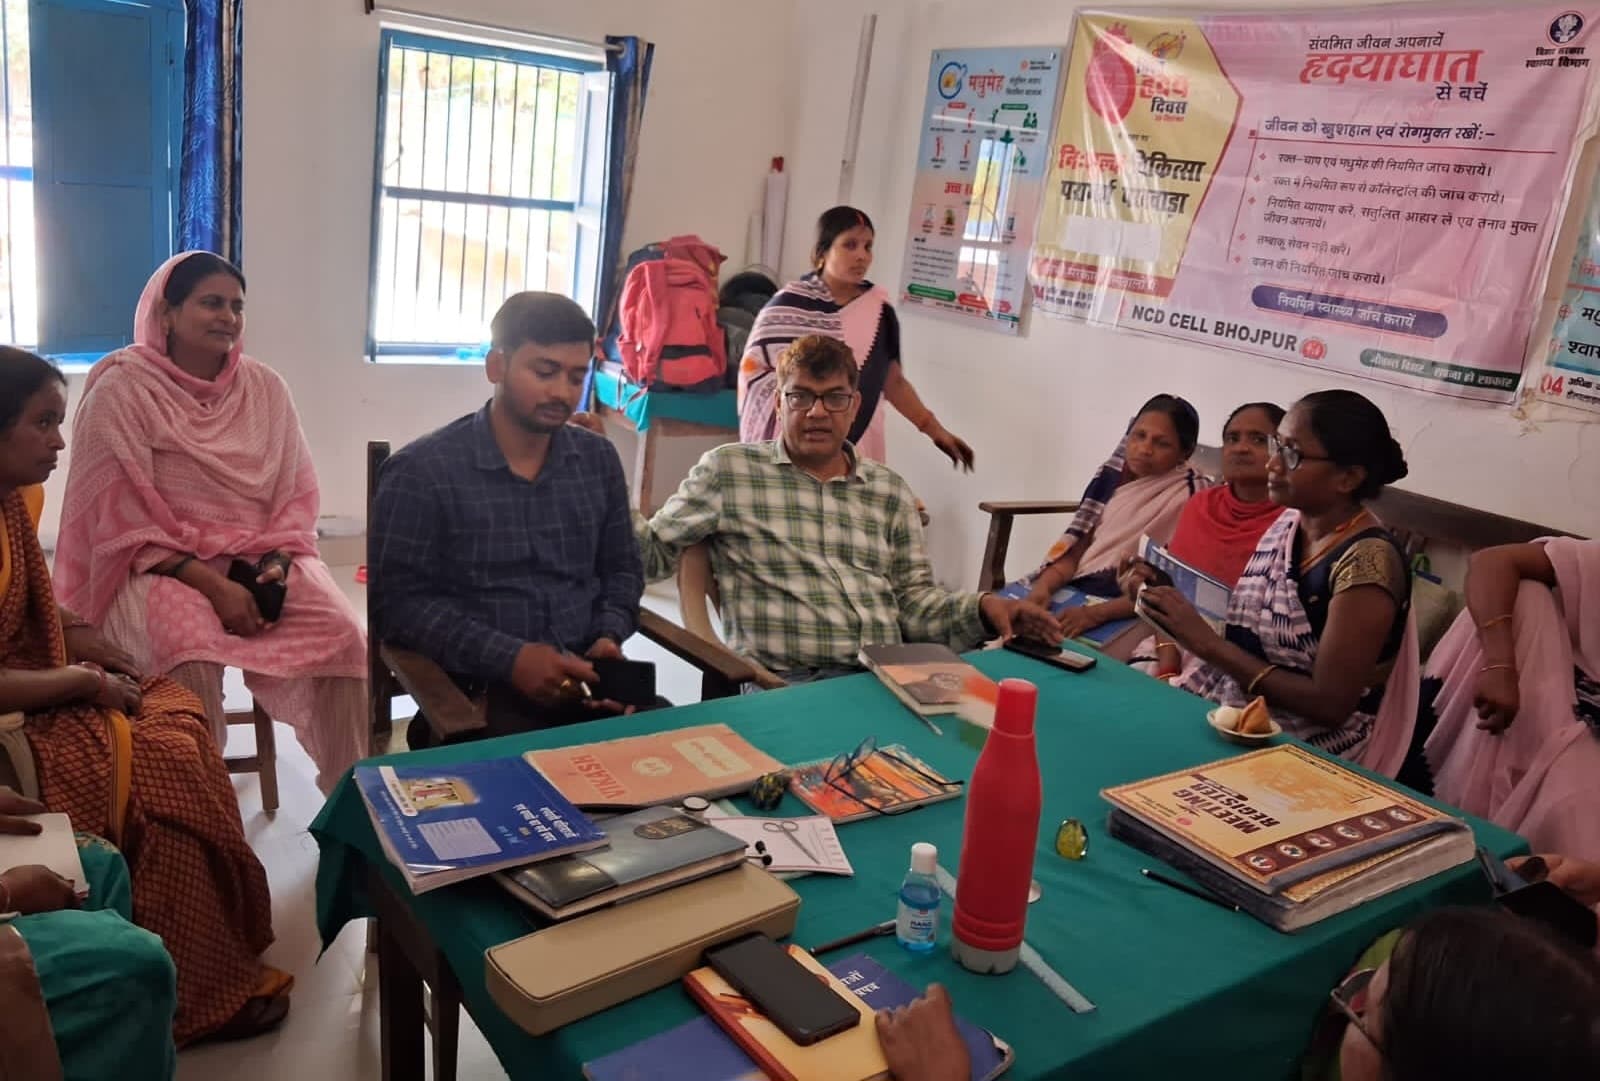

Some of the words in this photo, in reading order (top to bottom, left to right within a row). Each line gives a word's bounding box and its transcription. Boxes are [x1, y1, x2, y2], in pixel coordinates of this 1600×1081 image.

[1308, 35, 1352, 50] संयमित
[1356, 34, 1391, 49] जीवन
[1300, 50, 1484, 84] हृदयाघात
[1150, 96, 1189, 114] दिवस
[1435, 81, 1452, 101] से
[1265, 116, 1299, 133] जीवन
[1302, 117, 1318, 134] को
[1321, 121, 1373, 139] खुशहाल
[1132, 304, 1165, 324] NCD
[1169, 312, 1209, 334] CELL
[1213, 320, 1298, 352] BHOJPUR
[572, 754, 627, 800] VIKASH
[1173, 789, 1263, 835] MEETING
[1190, 783, 1281, 828] REGISTER
